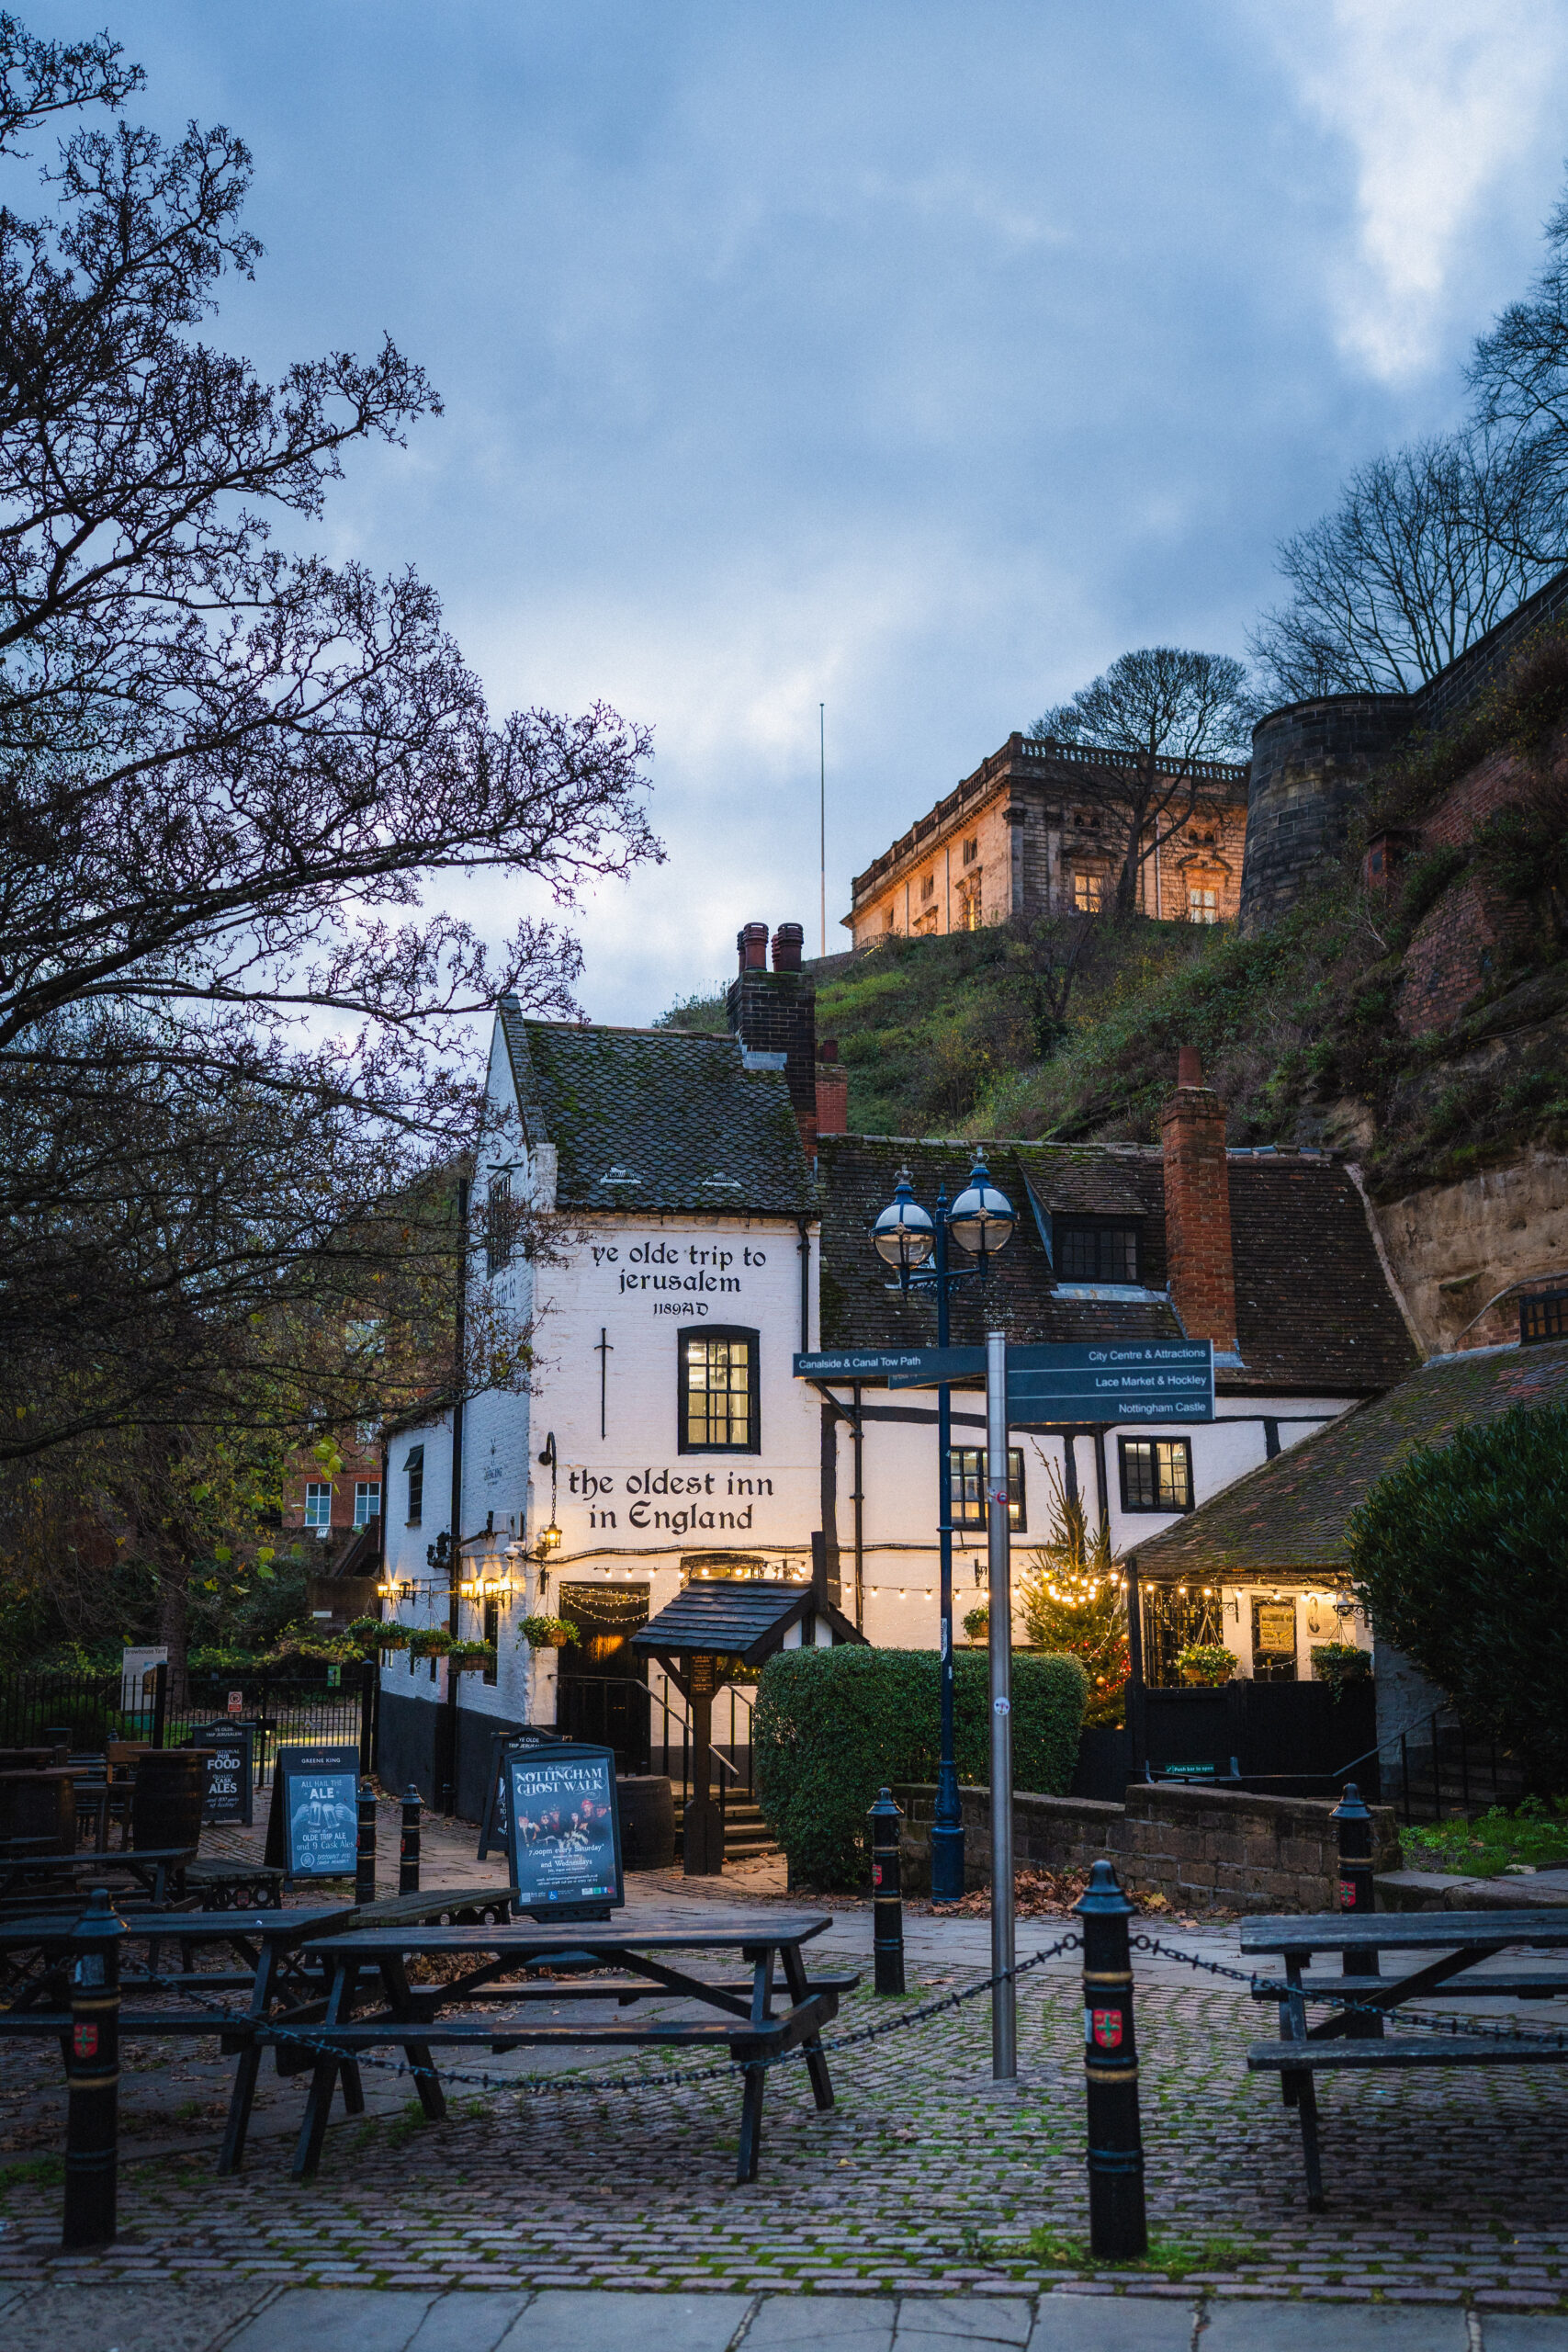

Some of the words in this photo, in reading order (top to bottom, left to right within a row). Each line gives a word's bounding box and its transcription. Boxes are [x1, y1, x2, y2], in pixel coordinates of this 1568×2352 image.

[592, 1246, 618, 1267] ye
[629, 1241, 679, 1264] olde
[689, 1245, 733, 1272] trip
[743, 1246, 767, 1267] to
[618, 1269, 742, 1295] jerusalem
[798, 1360, 842, 1370] Canalside
[843, 1359, 851, 1368] &
[852, 1357, 879, 1368] Canal
[880, 1357, 898, 1366] Tow
[899, 1355, 921, 1366] Path
[1089, 1351, 1108, 1363] City
[1110, 1351, 1143, 1360] Centre
[1145, 1350, 1153, 1359] &
[1154, 1348, 1206, 1359] Attractions
[1095, 1377, 1119, 1387] Lace
[1122, 1376, 1155, 1386] Market
[1157, 1375, 1165, 1385] &
[1167, 1374, 1207, 1386] Hockley
[1119, 1403, 1174, 1415] Nottingham
[1175, 1402, 1206, 1412] Castle
[569, 1467, 614, 1501] the
[626, 1467, 716, 1495] oldest
[727, 1471, 773, 1496] inn
[589, 1503, 617, 1529] in
[628, 1499, 753, 1536] England
[207, 1758, 241, 1770] FOOD
[515, 1768, 603, 1783] NOTTINGHAM
[209, 1782, 237, 1794] ALES
[310, 1787, 334, 1799] ALE
[516, 1781, 560, 1795] GHOST
[563, 1779, 604, 1793] WALK
[297, 1842, 310, 1850] and
[312, 1841, 318, 1849] 9
[321, 1840, 338, 1849] Cask
[339, 1839, 355, 1848] Ales
[528, 1849, 553, 1857] 7.00pm
[555, 1859, 592, 1867] Wednesdays
